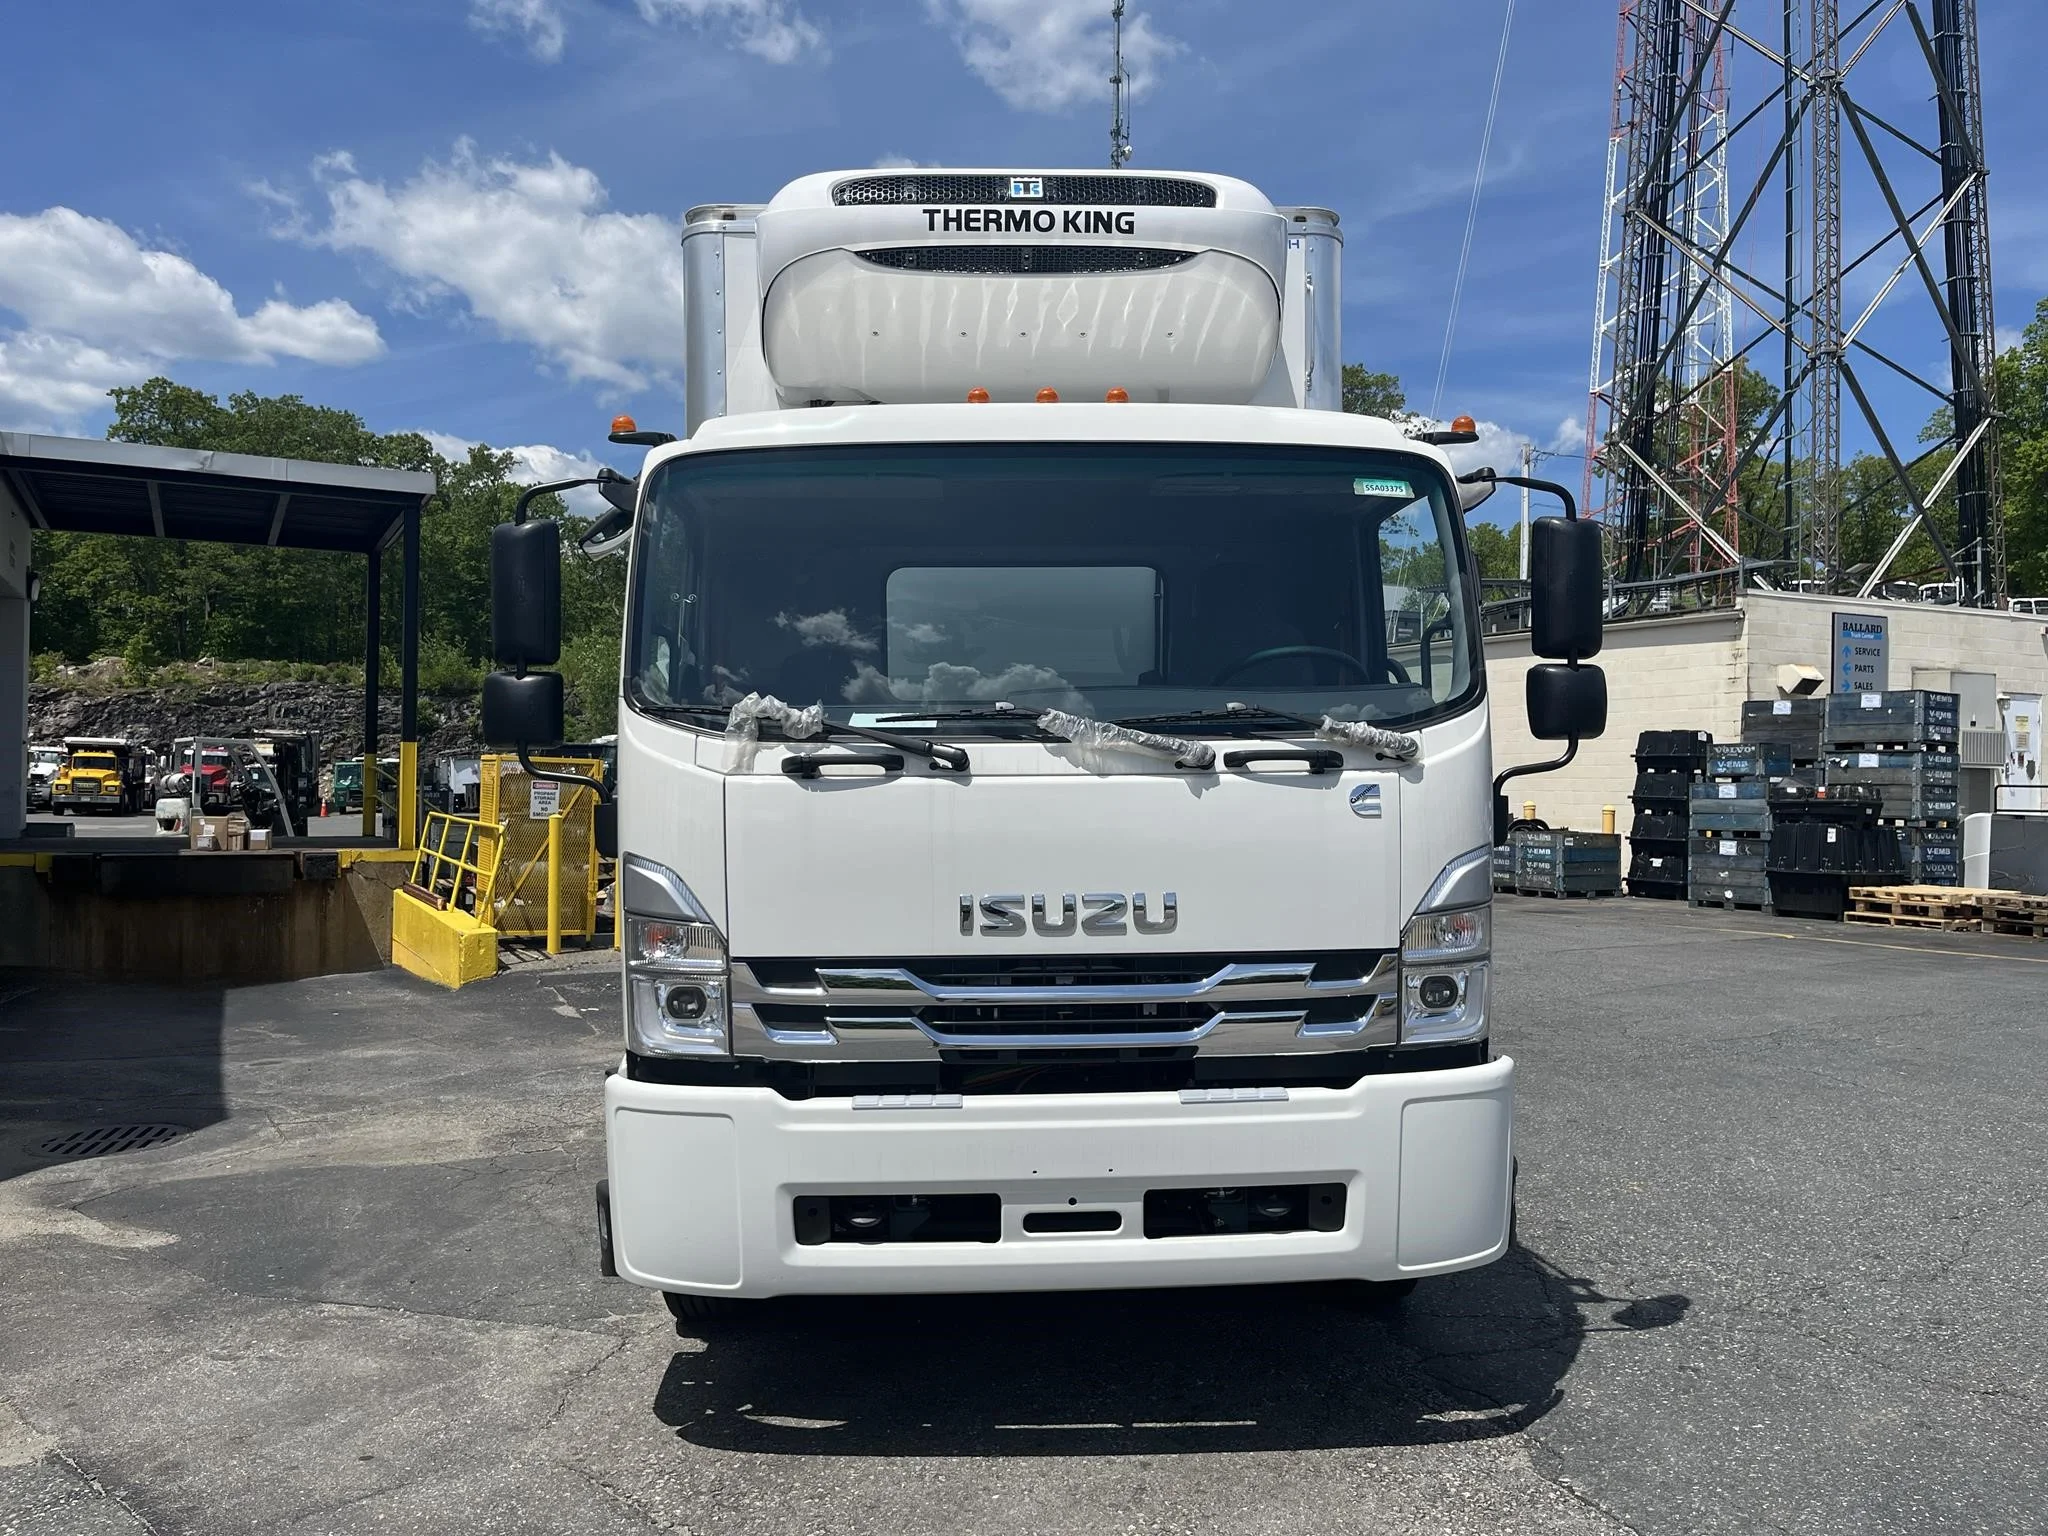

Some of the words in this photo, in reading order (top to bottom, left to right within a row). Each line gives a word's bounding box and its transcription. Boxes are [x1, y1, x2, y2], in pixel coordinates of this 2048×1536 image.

[923, 209, 1056, 233] THERMO
[1063, 211, 1135, 235] KING
[1842, 622, 1883, 633] BALLARD
[1854, 647, 1881, 656] SERVICE
[1854, 664, 1875, 673] PARTS
[1854, 682, 1873, 690] SALES
[1713, 745, 1751, 753] VOLVO
[1925, 864, 1953, 872] VOLVO
[959, 892, 1178, 937] ISUZU
